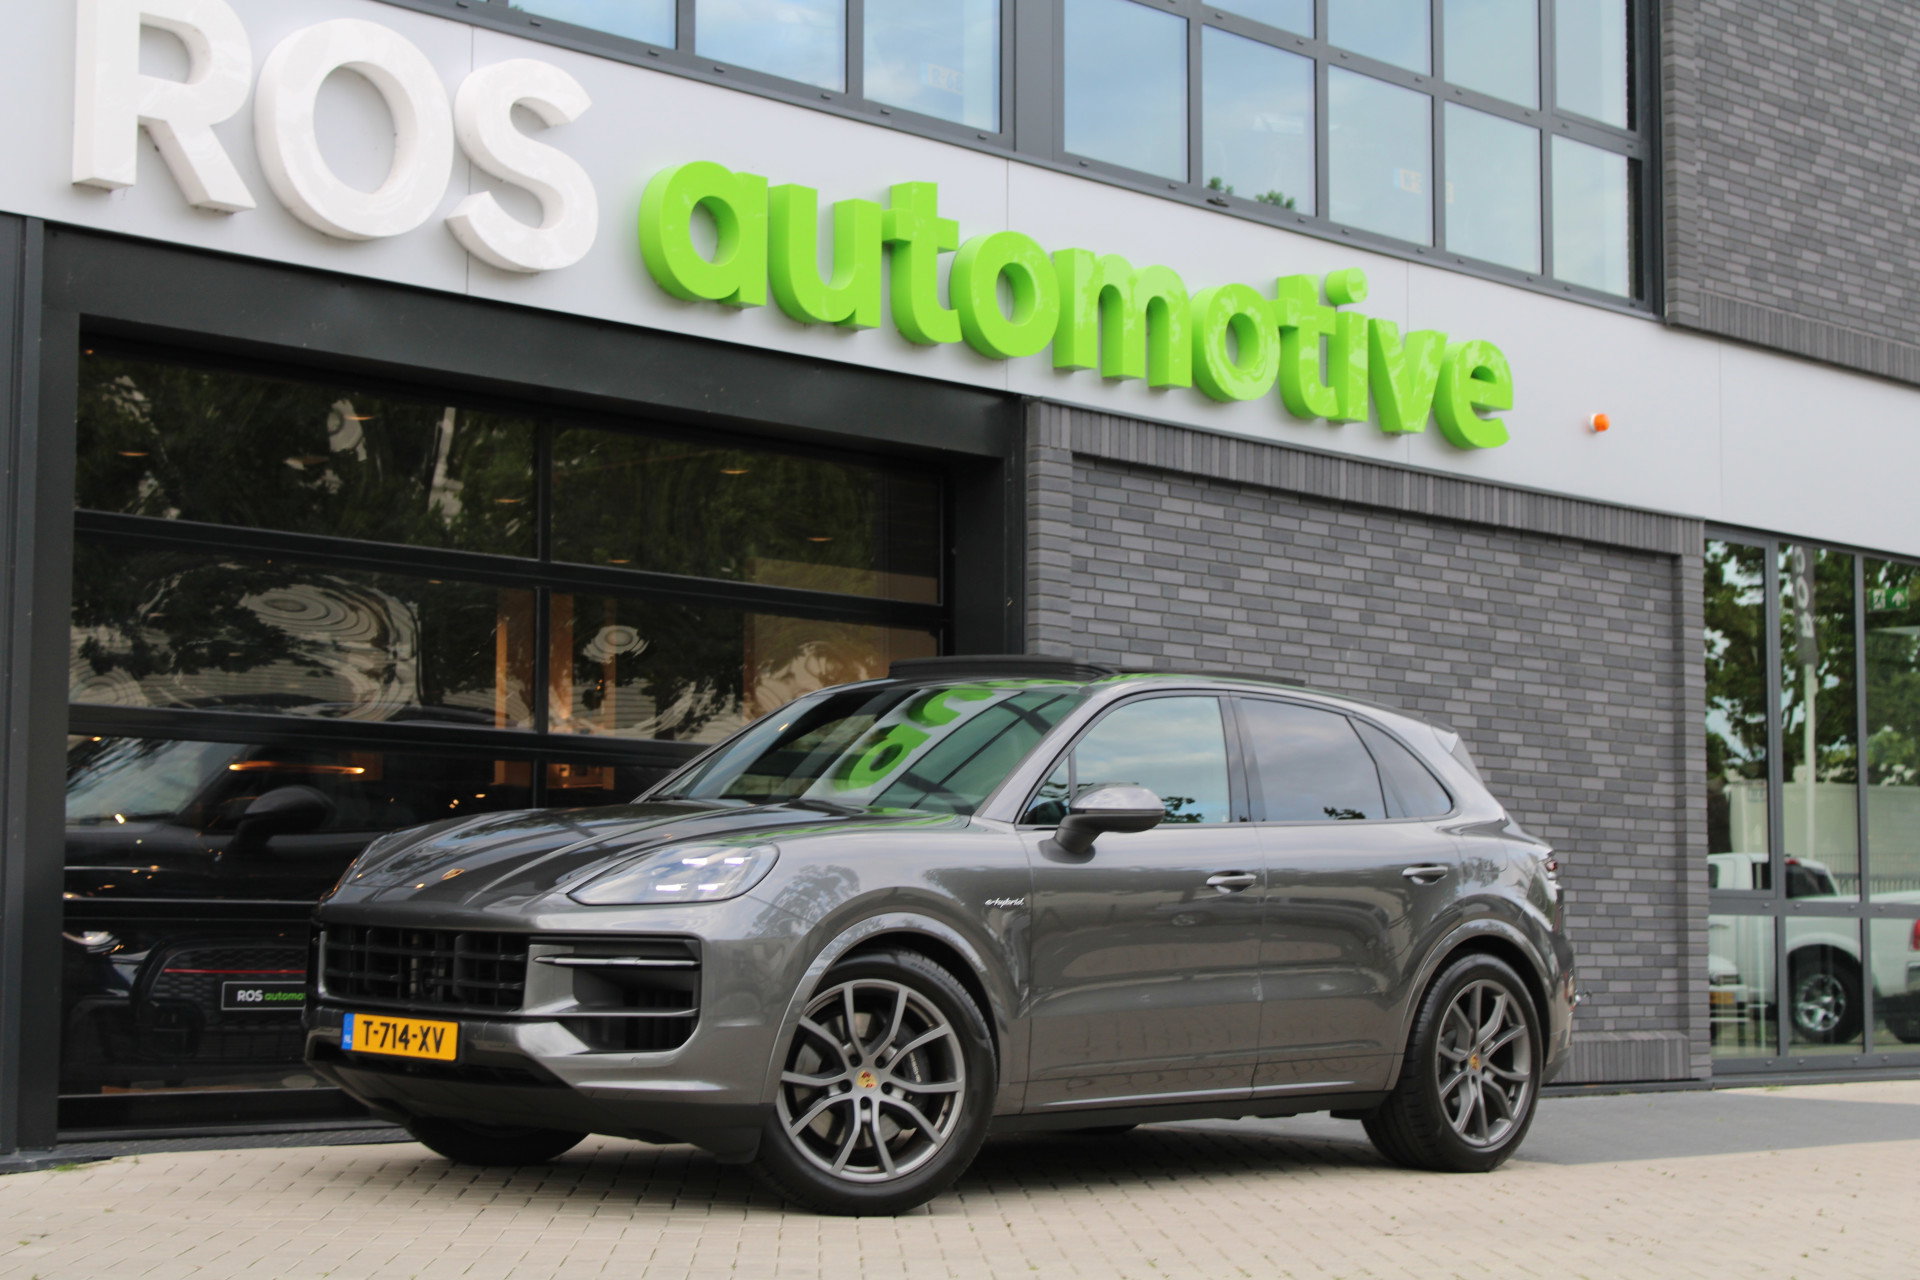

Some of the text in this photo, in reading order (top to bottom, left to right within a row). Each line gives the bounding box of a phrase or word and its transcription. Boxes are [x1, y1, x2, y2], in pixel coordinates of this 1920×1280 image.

[72, 0, 1514, 450] ROS automotive
[237, 989, 306, 1002] ROS automo
[362, 1020, 446, 1054] T-714-XV
